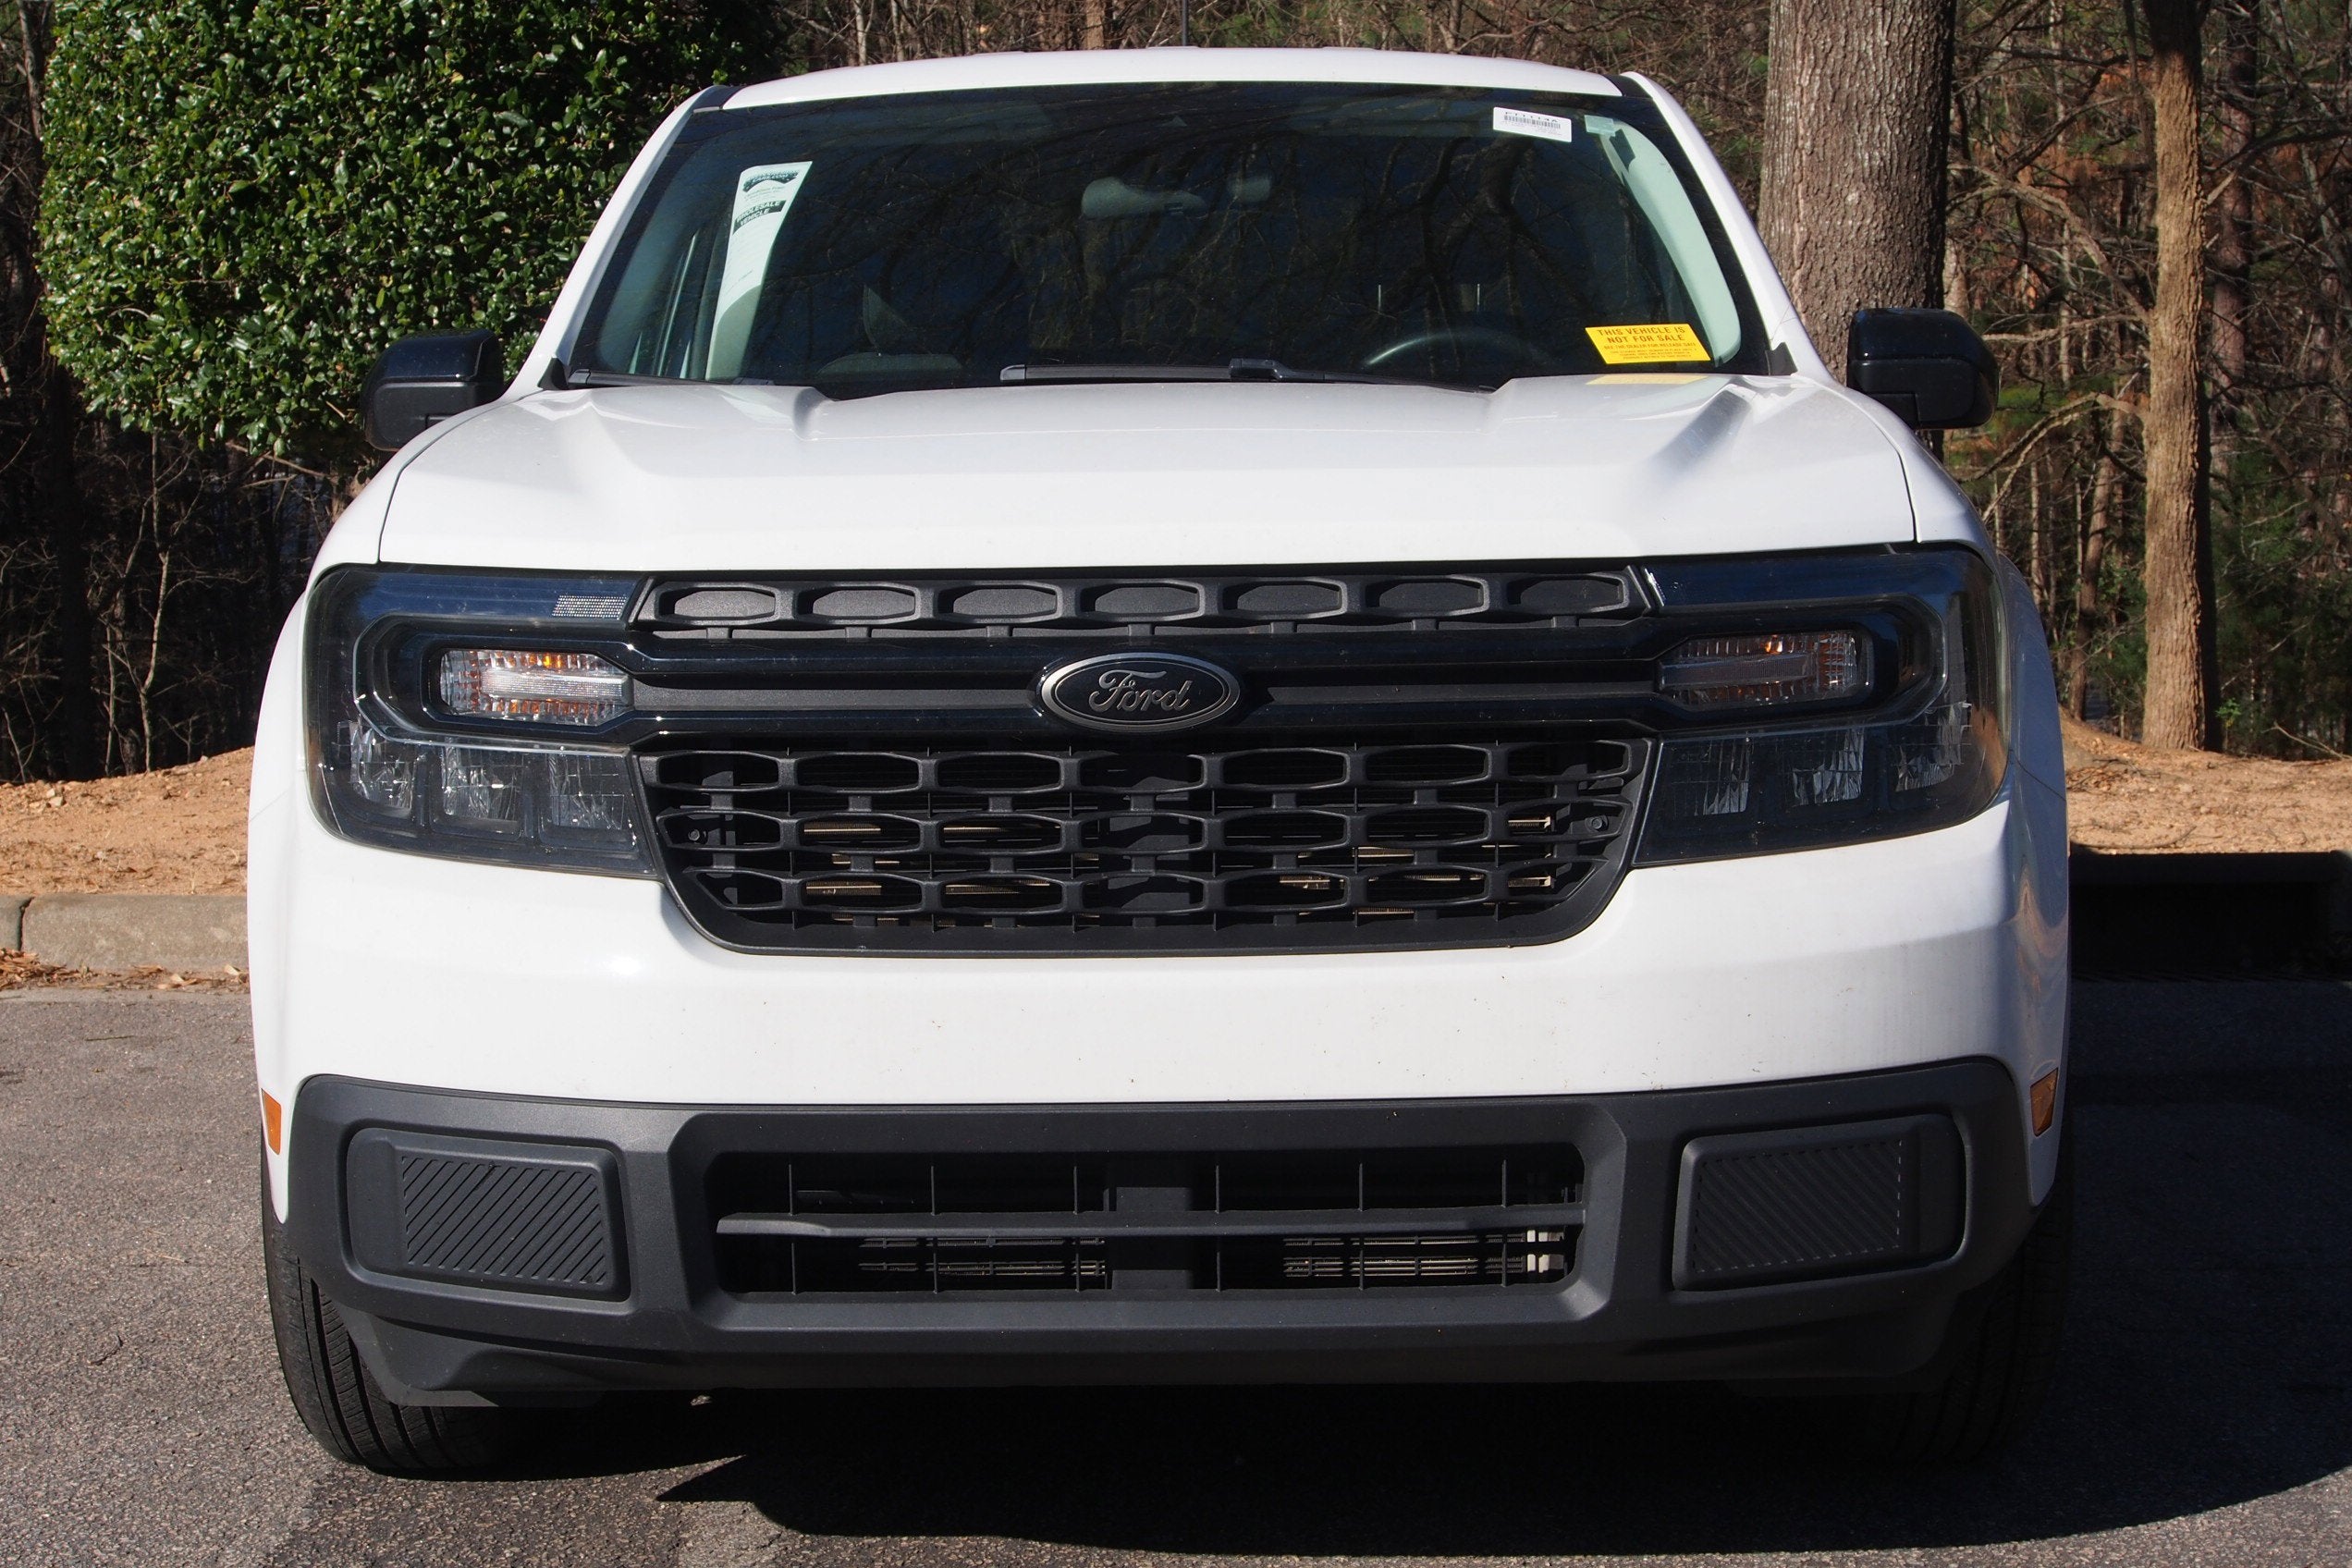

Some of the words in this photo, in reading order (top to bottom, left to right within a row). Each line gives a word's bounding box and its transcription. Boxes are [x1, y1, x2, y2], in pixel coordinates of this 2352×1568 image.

[1624, 326, 1670, 335] VEHICLE
[1607, 336, 1627, 344] NOT
[1634, 335, 1654, 343] FOR
[1657, 334, 1685, 342] SALE
[1088, 669, 1194, 713] Ford
